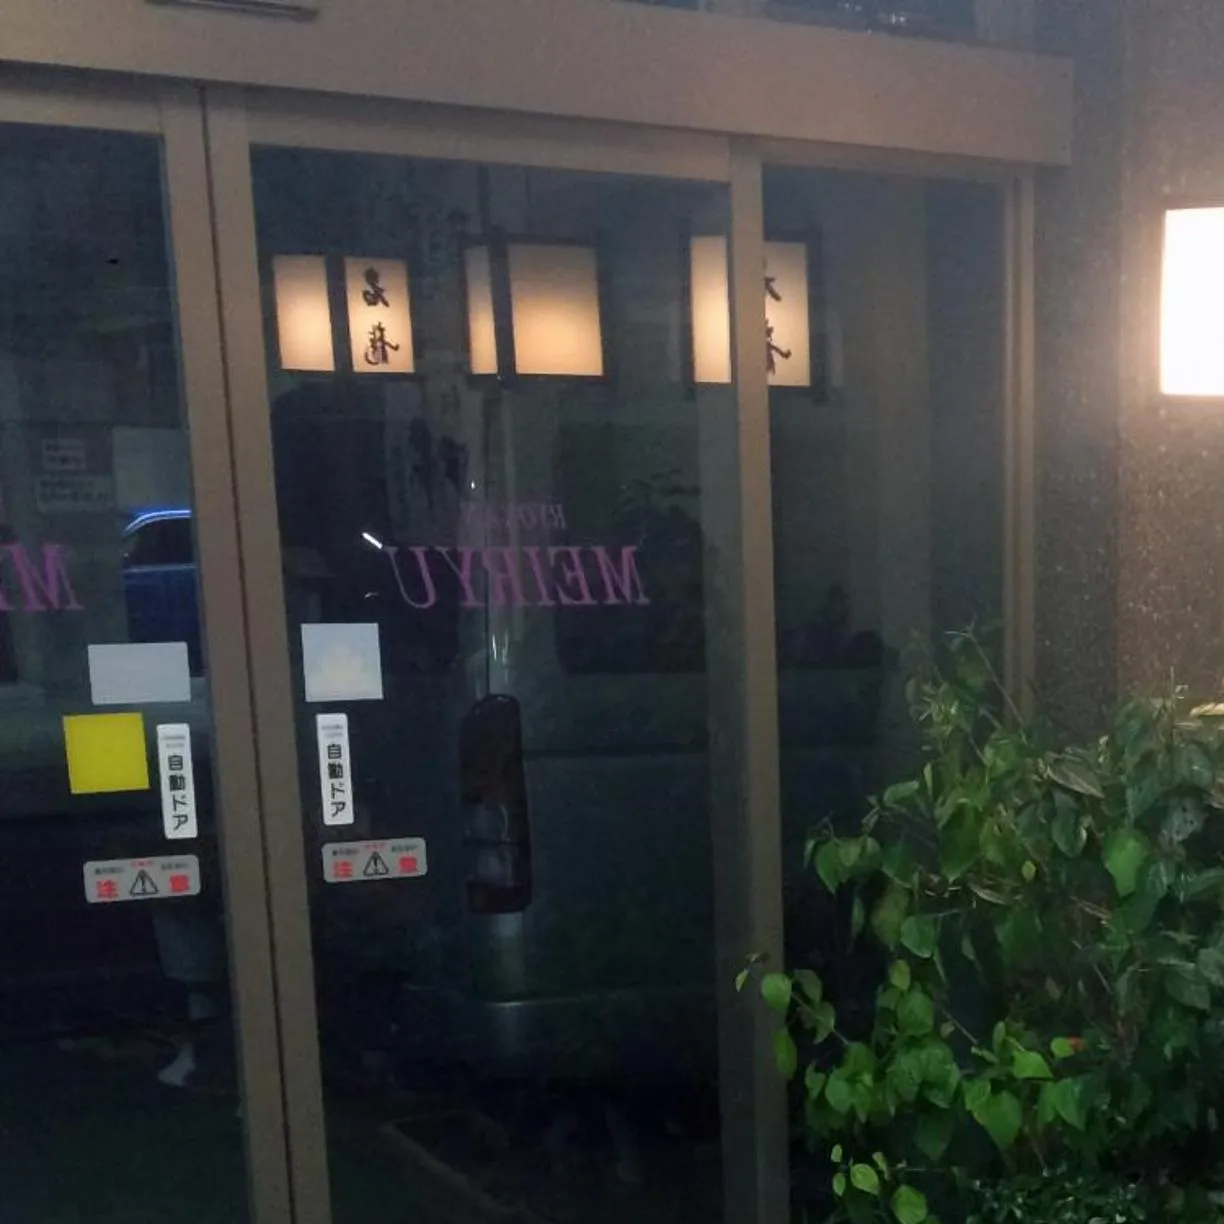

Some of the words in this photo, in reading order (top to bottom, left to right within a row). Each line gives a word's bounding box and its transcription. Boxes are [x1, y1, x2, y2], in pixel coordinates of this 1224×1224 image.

[167, 754, 190, 832] 自動ドア
[326, 743, 347, 818] 自動ドア
